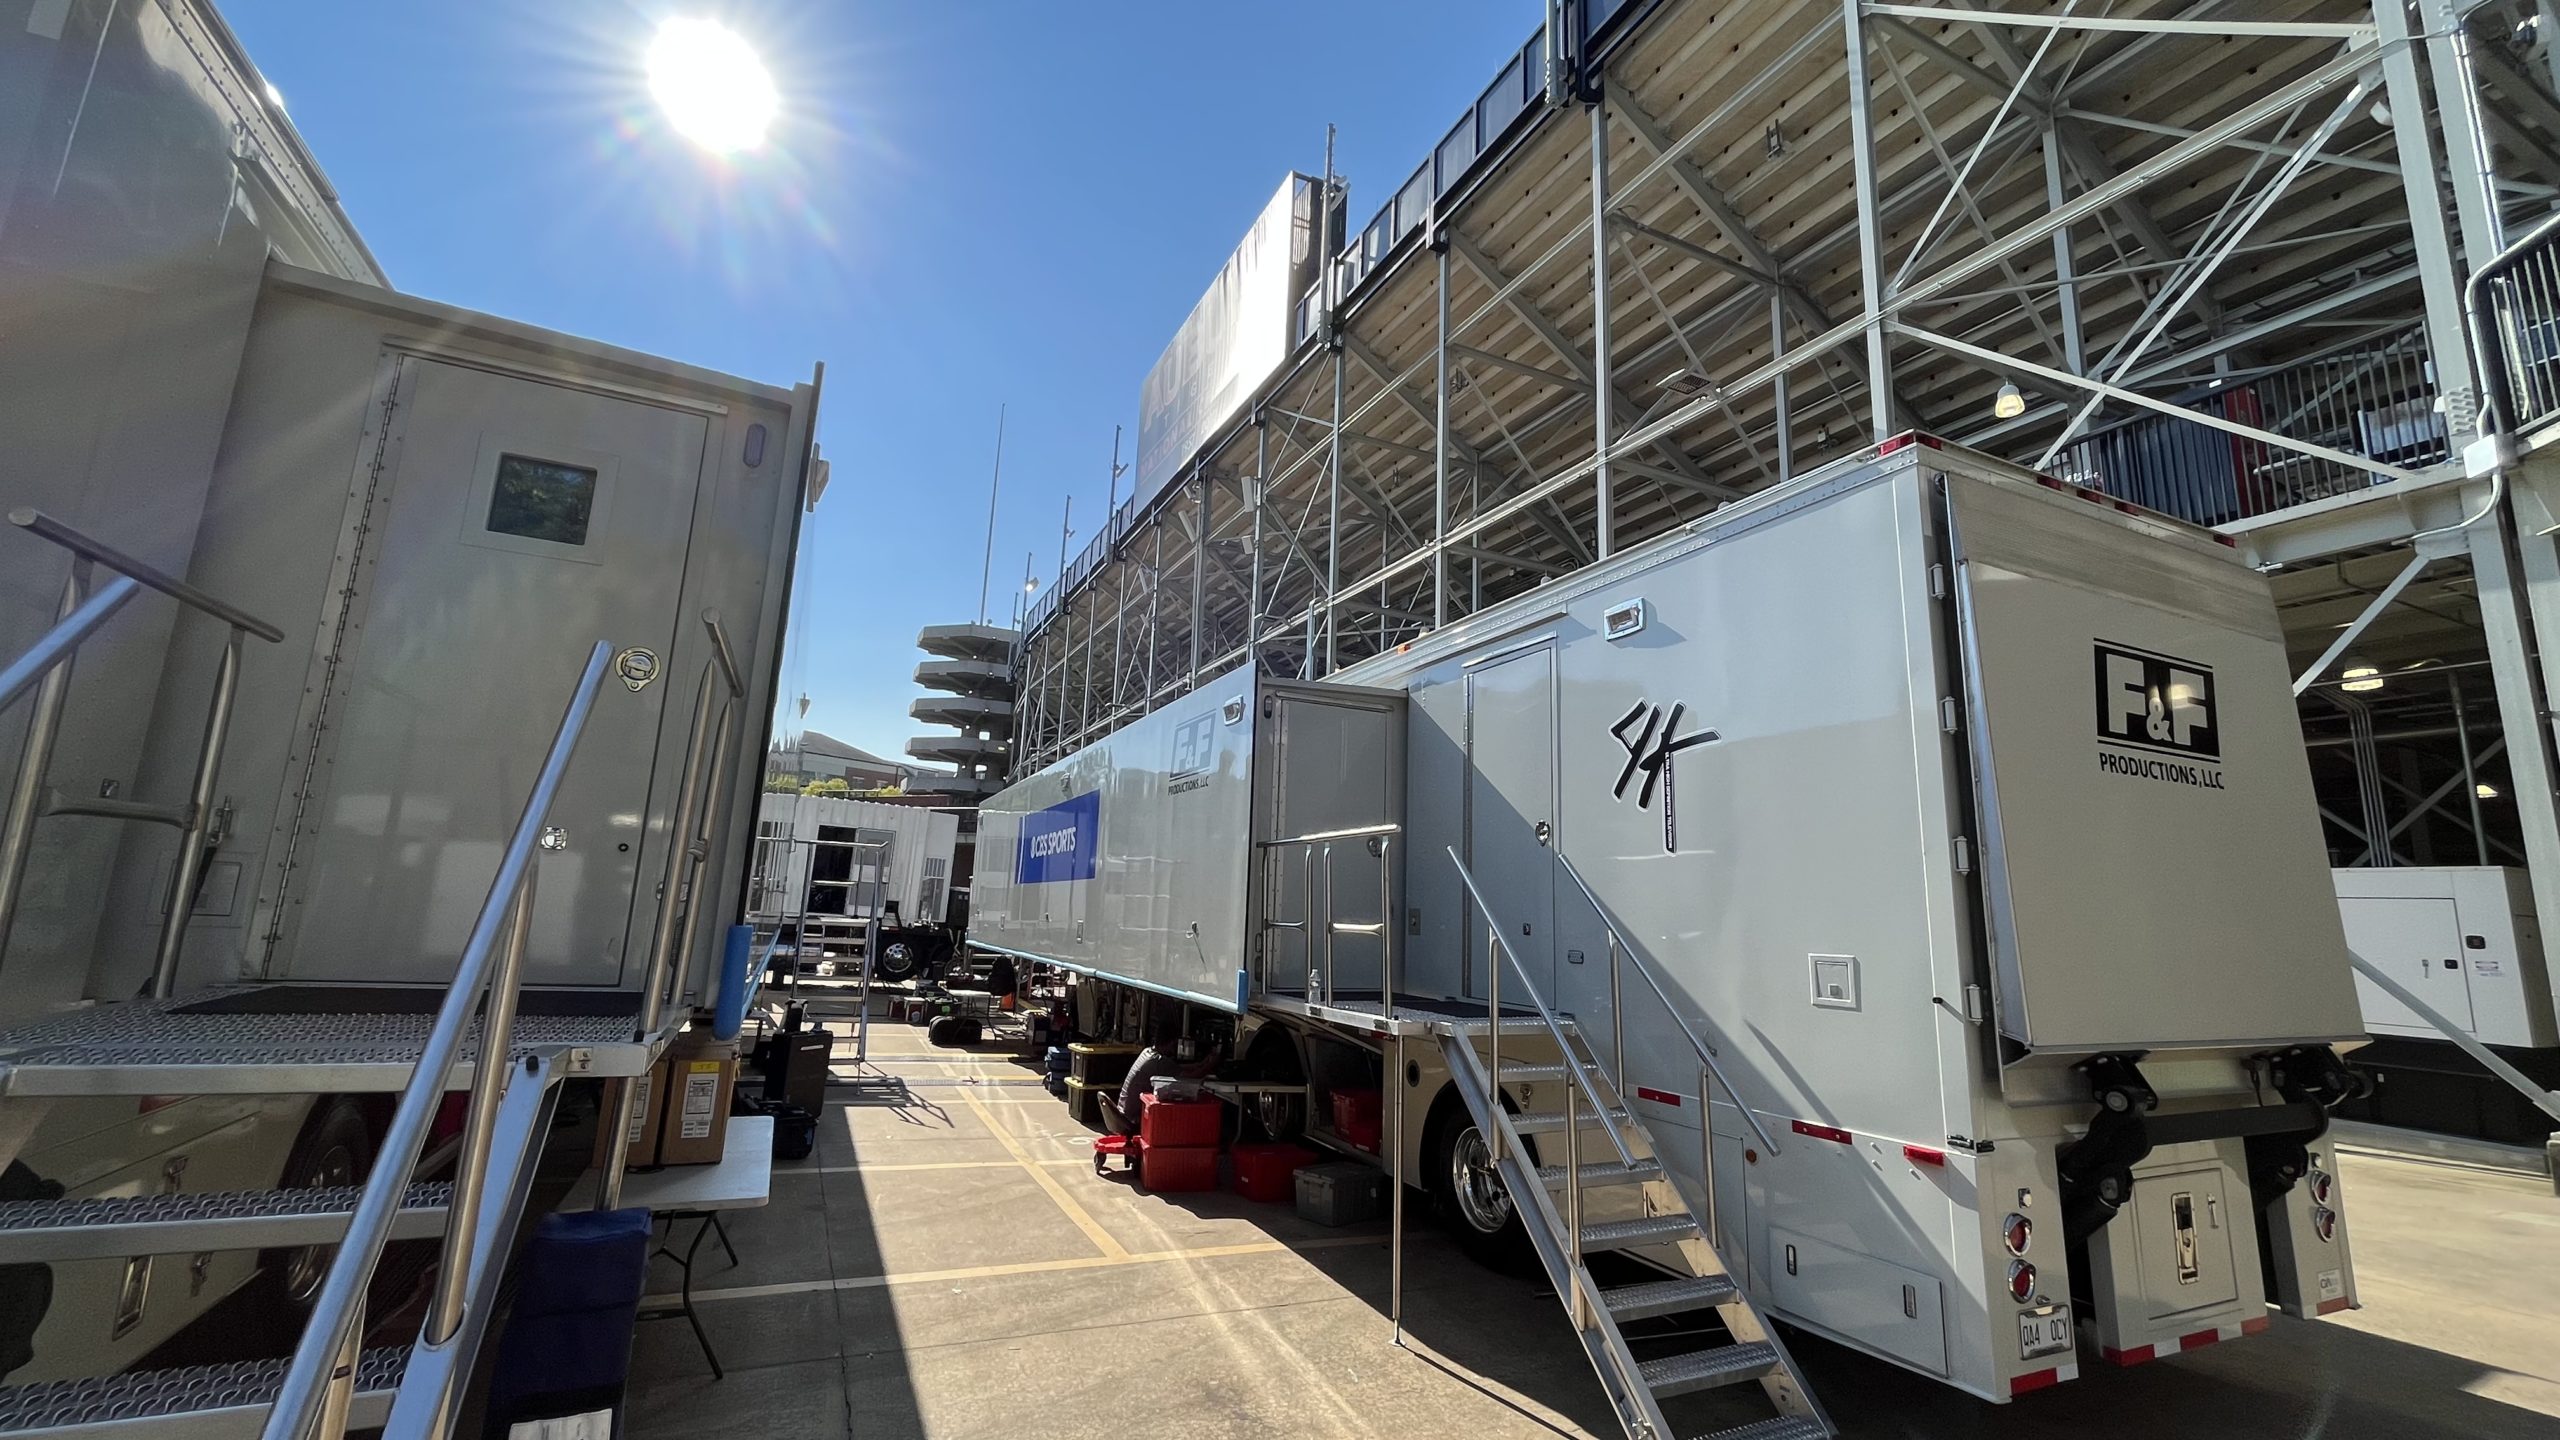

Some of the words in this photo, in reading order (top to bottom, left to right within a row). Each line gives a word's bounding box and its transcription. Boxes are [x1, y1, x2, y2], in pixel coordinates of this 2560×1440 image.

[2104, 652, 2210, 747] F&F
[1036, 834, 1048, 857] CBS
[1047, 826, 1077, 855] SPORTS
